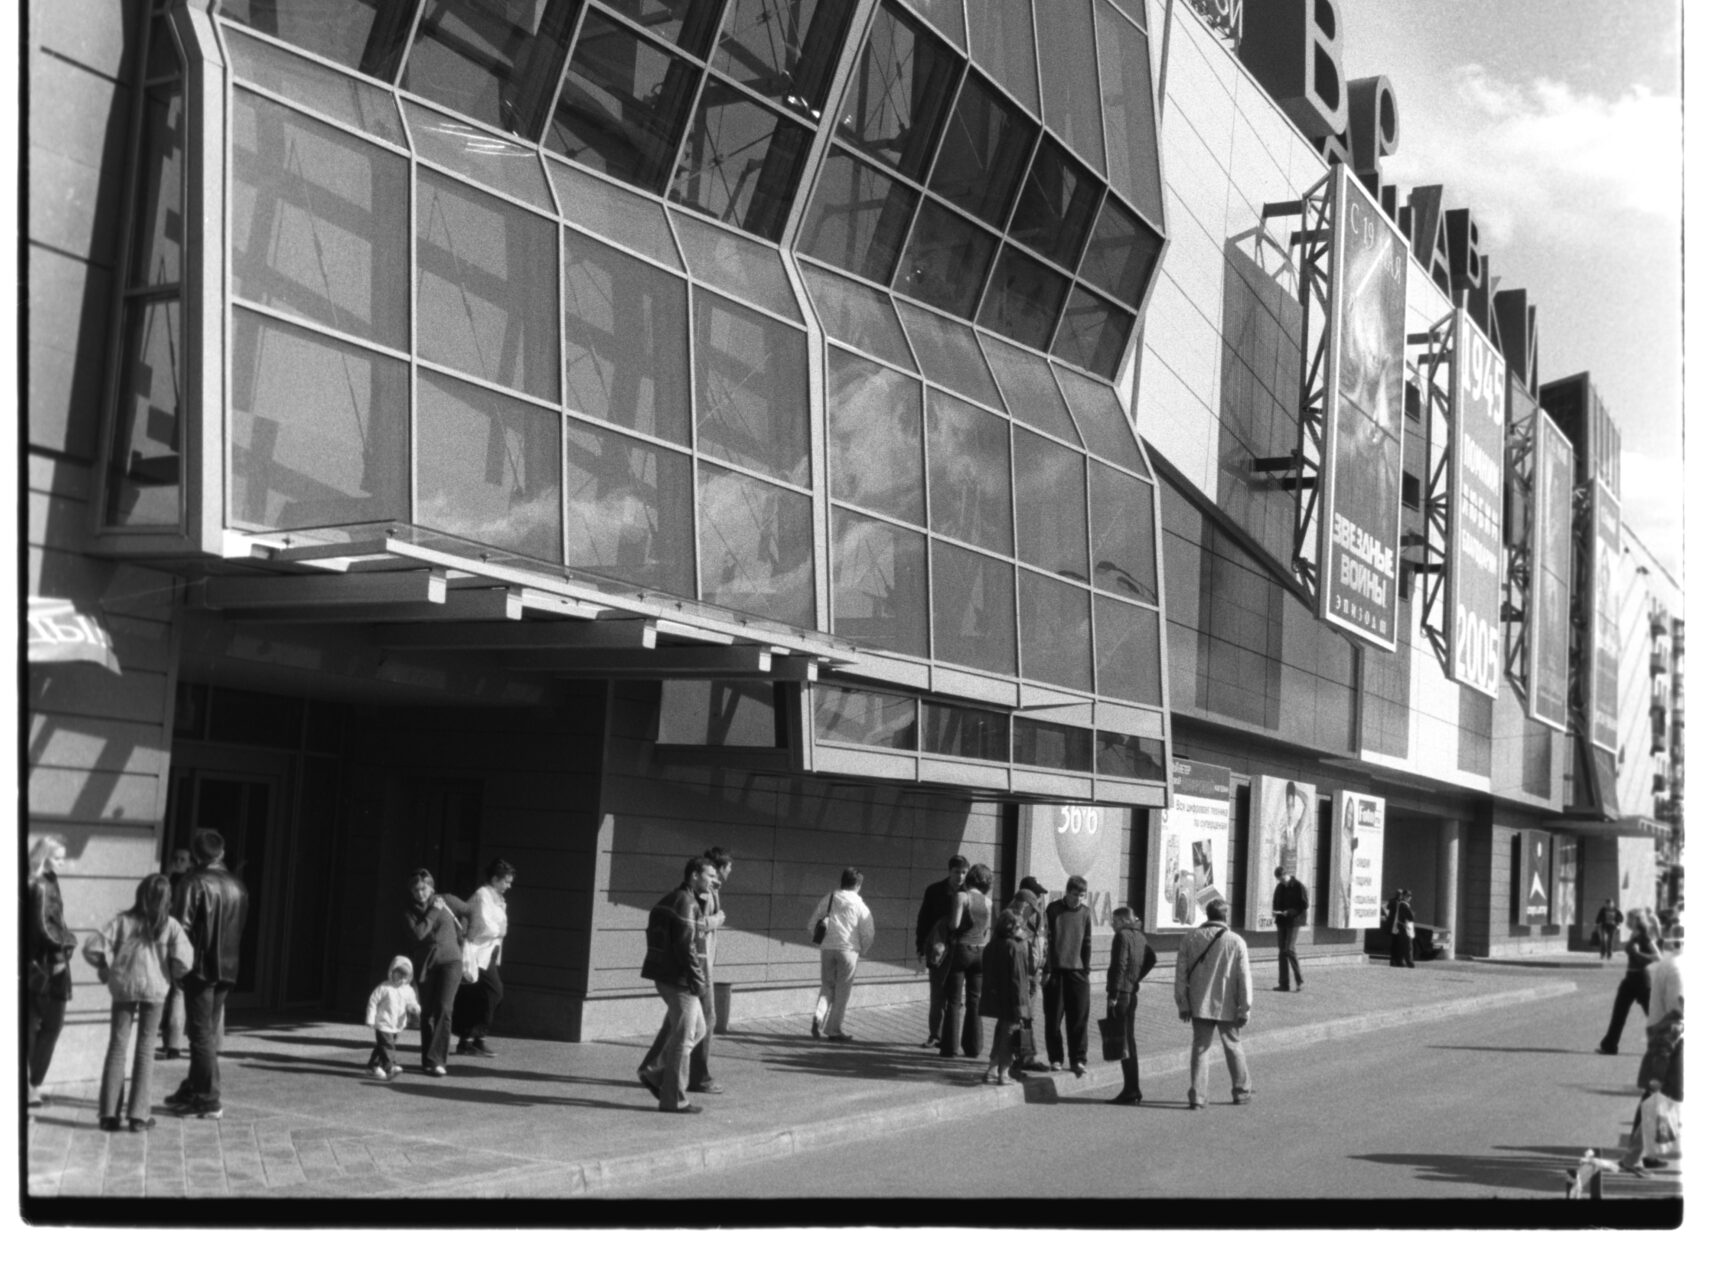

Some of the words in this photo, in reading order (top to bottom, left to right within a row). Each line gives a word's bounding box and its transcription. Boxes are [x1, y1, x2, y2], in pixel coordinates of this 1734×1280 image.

[1363, 217, 1375, 250] 19
[1462, 320, 1503, 427] 1945
[1333, 511, 1395, 580] ЗВЕЗДНЫЕ
[1335, 593, 1378, 630] ЭПИЗОД
[1340, 553, 1388, 609] ВОЙНЫ
[1456, 603, 1499, 694] 2005
